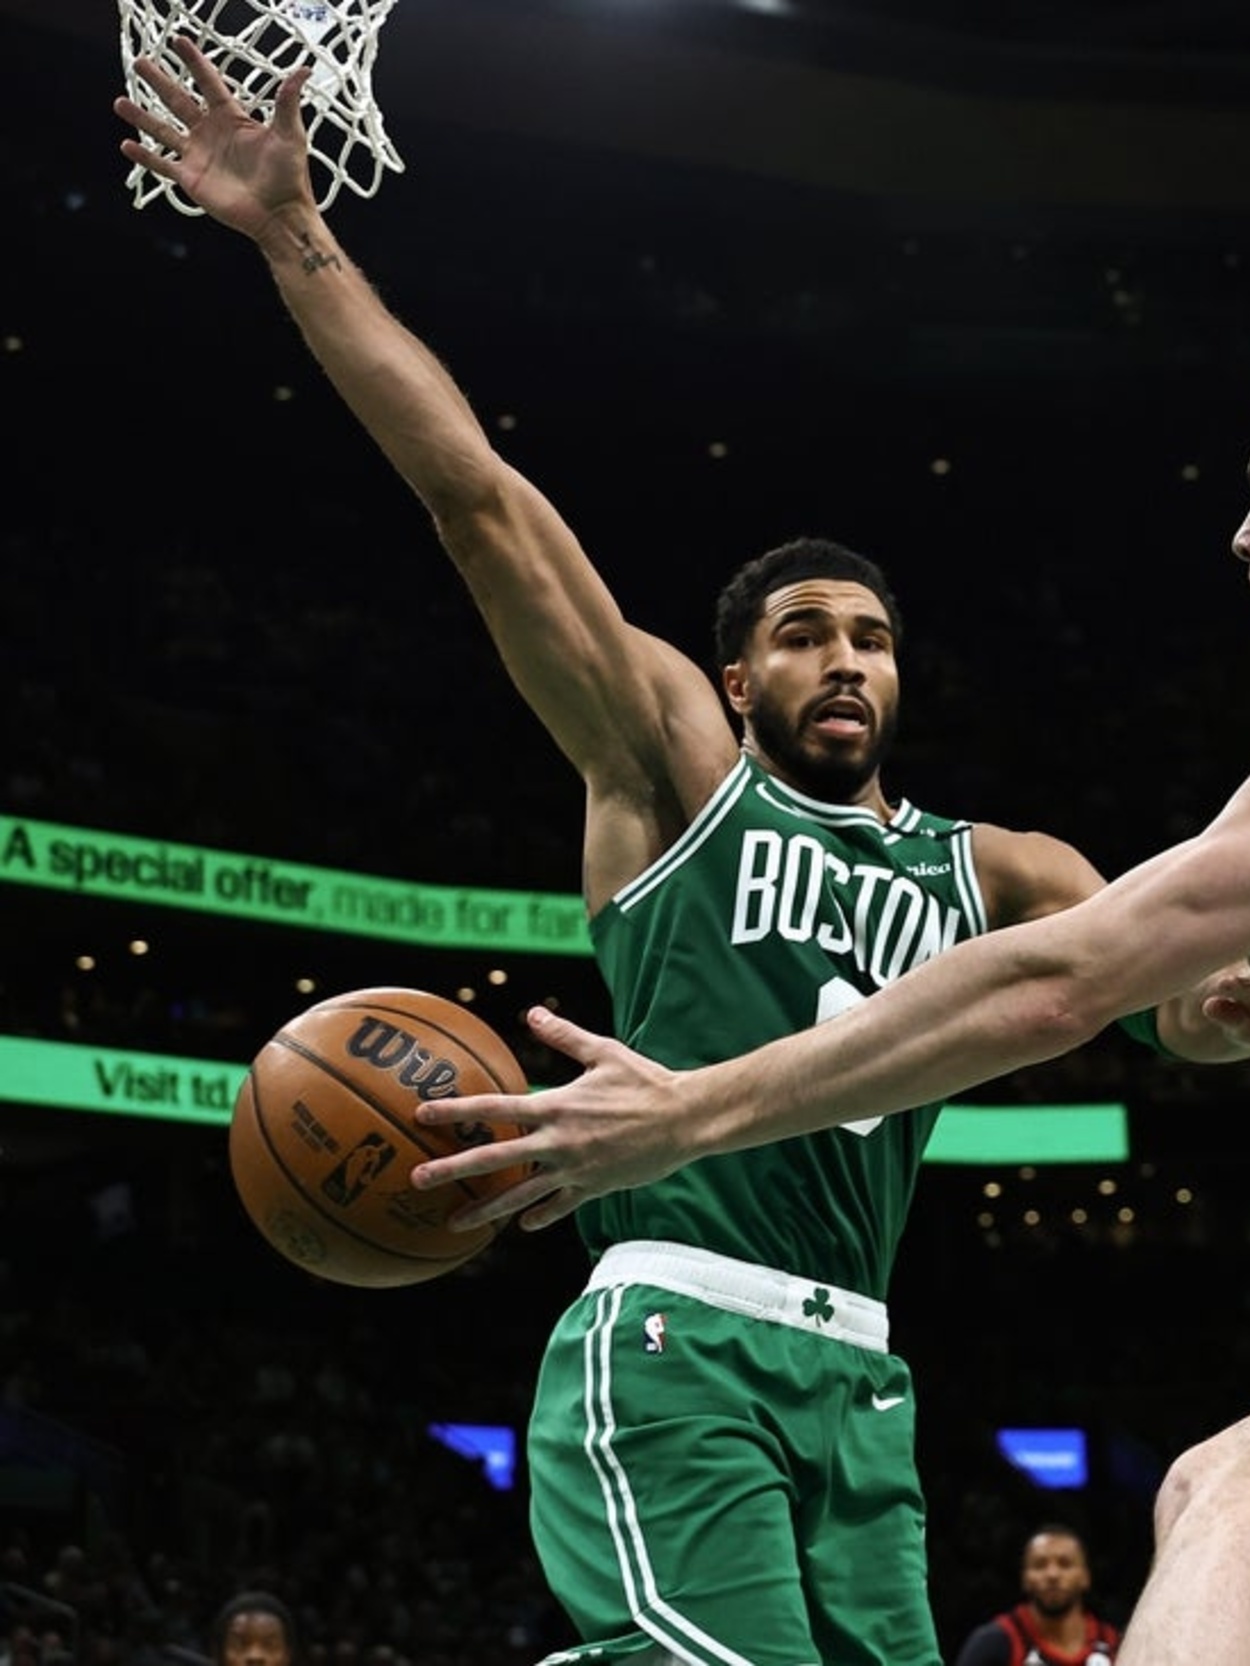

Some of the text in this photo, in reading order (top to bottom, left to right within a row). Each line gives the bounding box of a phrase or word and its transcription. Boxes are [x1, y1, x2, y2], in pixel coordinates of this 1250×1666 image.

[3, 825, 36, 869] A
[48, 839, 206, 894] special
[331, 884, 446, 934] made
[456, 888, 509, 935] for
[731, 829, 960, 988] BOSTON
[94, 1056, 179, 1105] Visit
